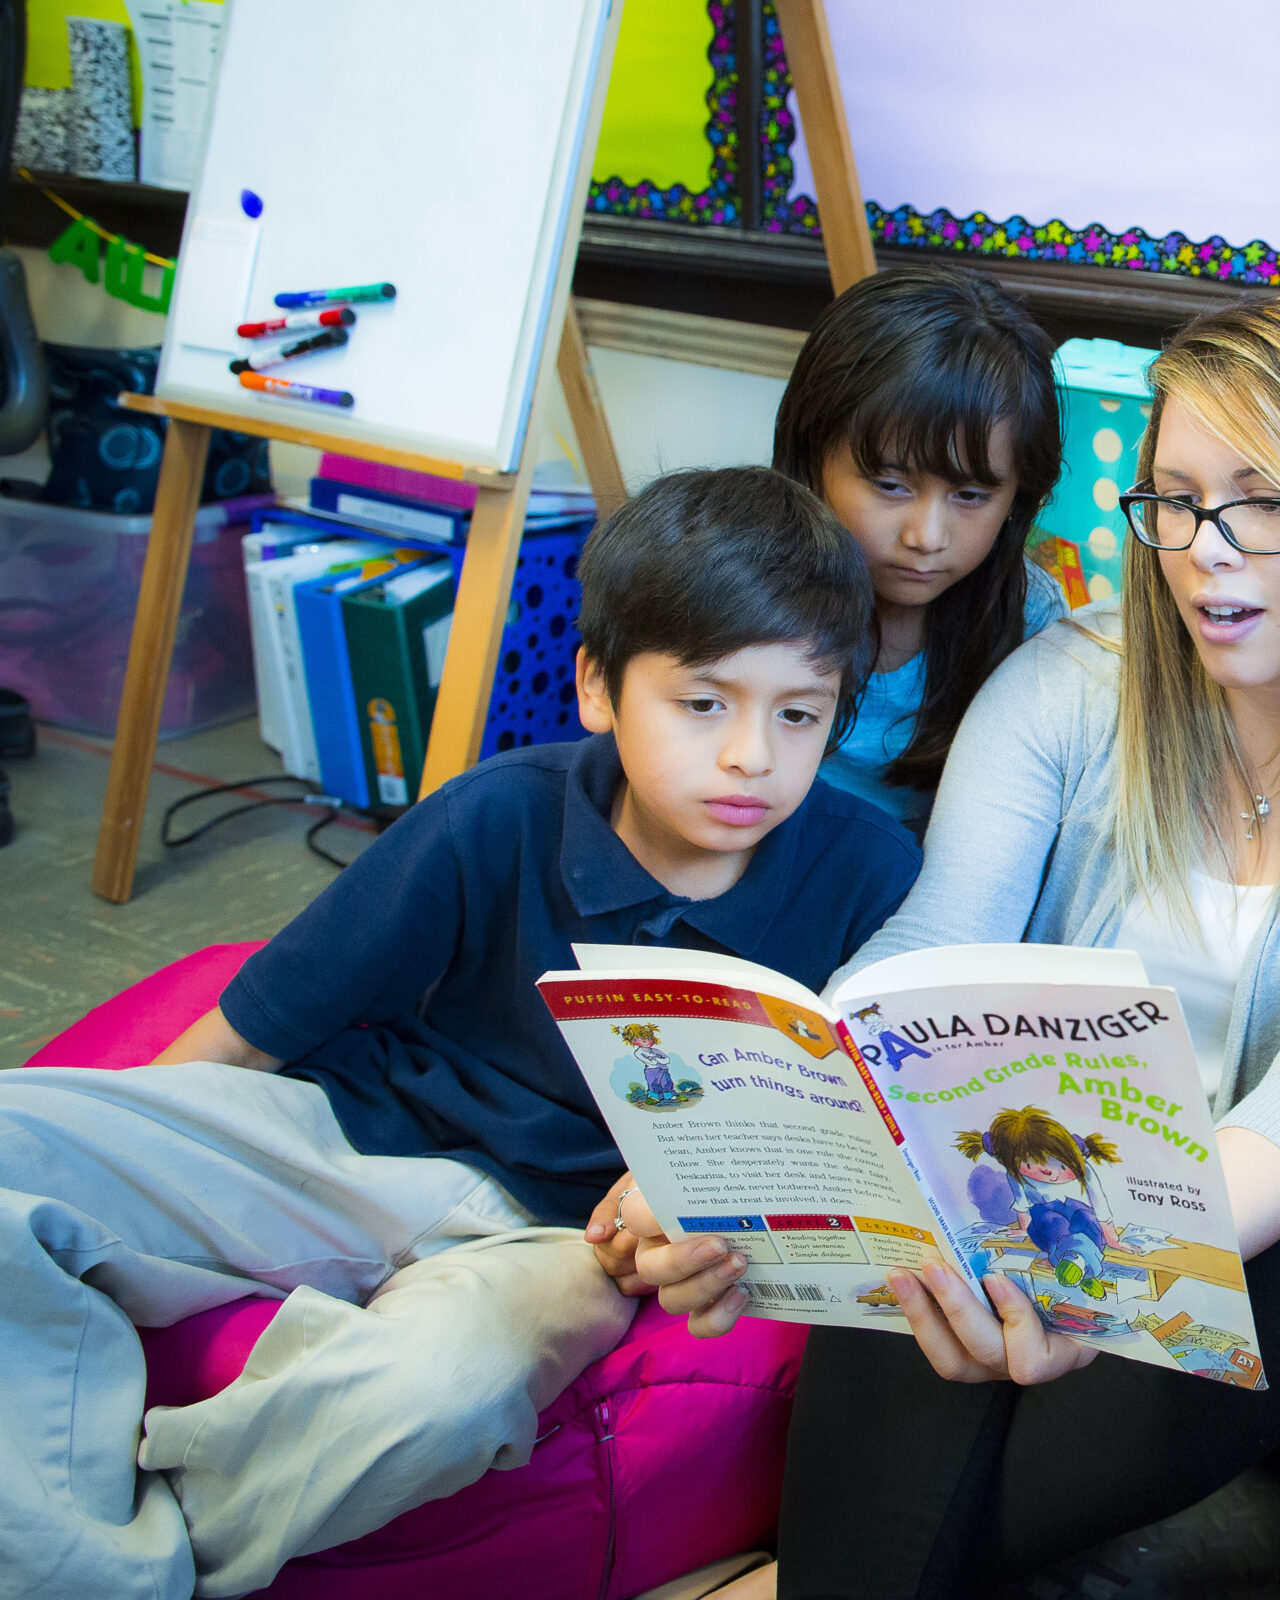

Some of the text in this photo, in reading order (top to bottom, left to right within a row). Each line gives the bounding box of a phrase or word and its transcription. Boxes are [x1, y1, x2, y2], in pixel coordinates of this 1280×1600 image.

[564, 993, 751, 1010] PUFFIN EASY-TO-READ
[860, 1000, 1169, 1072] PAULA DANZIGER
[966, 1040, 1004, 1048] Amber
[698, 1047, 848, 1087] Can Amber Brown
[841, 1034, 862, 1062] PUFFIN
[854, 1060, 888, 1110] EASY-TO-READ
[887, 1052, 1148, 1104] Second Grade Rules,
[711, 1075, 747, 1092] turn
[750, 1075, 805, 1099] things
[1058, 1071, 1183, 1117] Amber
[652, 1120, 683, 1129] Amber
[688, 1120, 721, 1128] Brown
[725, 1120, 756, 1128] thinks
[1100, 1098, 1209, 1162] Brown
[705, 1133, 721, 1141] her
[785, 1135, 811, 1143] desks
[664, 1147, 692, 1155] clean,
[695, 1146, 726, 1154] Amber
[729, 1145, 761, 1153] knows
[764, 1145, 783, 1153] that
[731, 1158, 785, 1167] desperately
[784, 1171, 806, 1179] desk
[692, 1186, 721, 1194] messy
[822, 1185, 852, 1194] Amber
[1187, 1184, 1201, 1196] by
[1128, 1188, 1207, 1212] Tony Ross
[829, 1217, 840, 1228] 2
[865, 1222, 908, 1234] LEVEL
[926, 1196, 941, 1216] SECOND
[936, 1215, 949, 1232] GRADE
[952, 1246, 965, 1263] AMBER
[960, 1261, 974, 1280] BROWN
